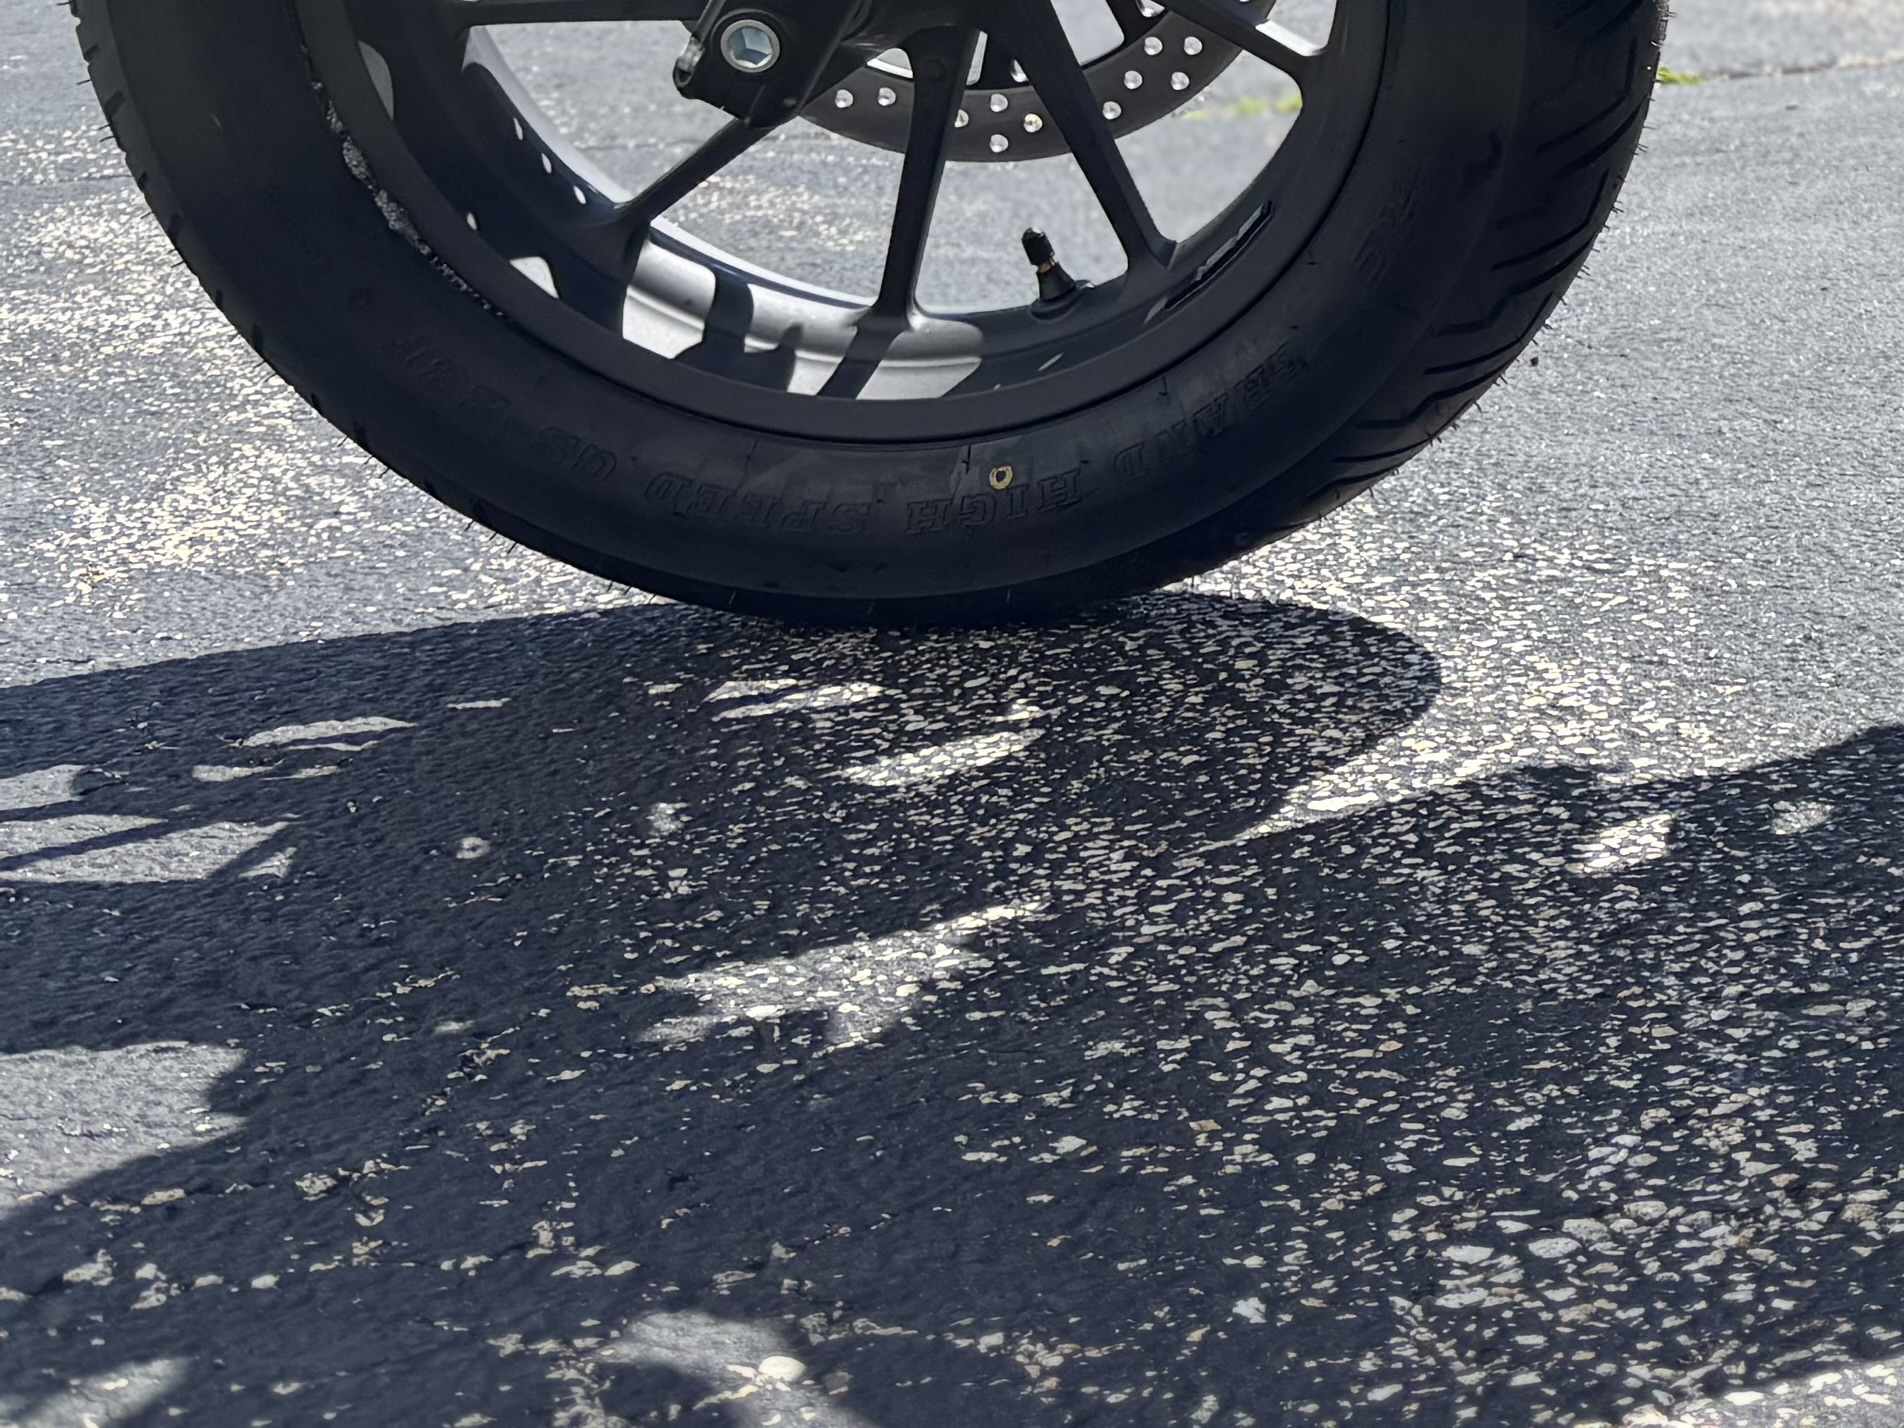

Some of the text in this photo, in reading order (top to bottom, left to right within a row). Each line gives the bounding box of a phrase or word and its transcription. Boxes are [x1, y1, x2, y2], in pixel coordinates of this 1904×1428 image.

[1112, 337, 1309, 486] GRAND
[643, 471, 874, 535] SPEED
[902, 468, 1084, 535] HIGH
